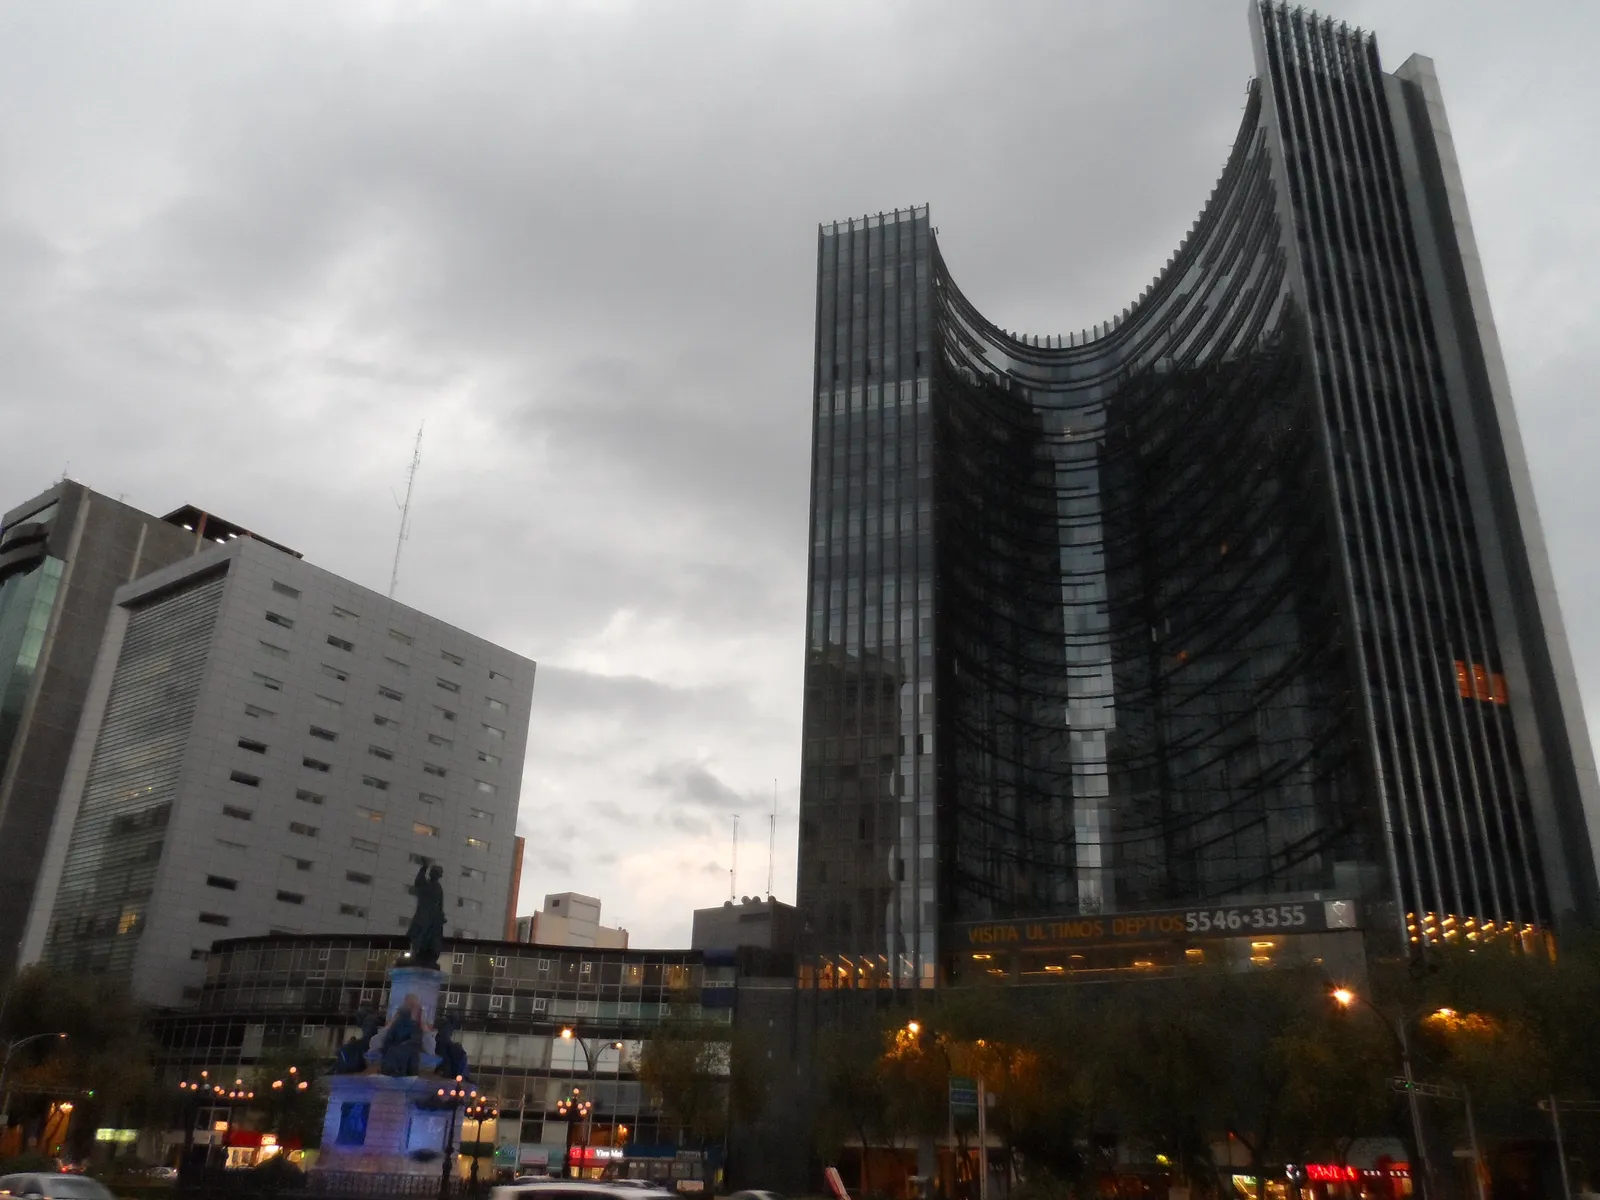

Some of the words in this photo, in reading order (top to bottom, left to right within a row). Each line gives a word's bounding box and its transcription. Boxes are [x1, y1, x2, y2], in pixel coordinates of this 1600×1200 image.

[968, 925, 1019, 943] VISITA
[1025, 920, 1104, 940] ULTIMOS
[1112, 914, 1185, 936] DEPTOS
